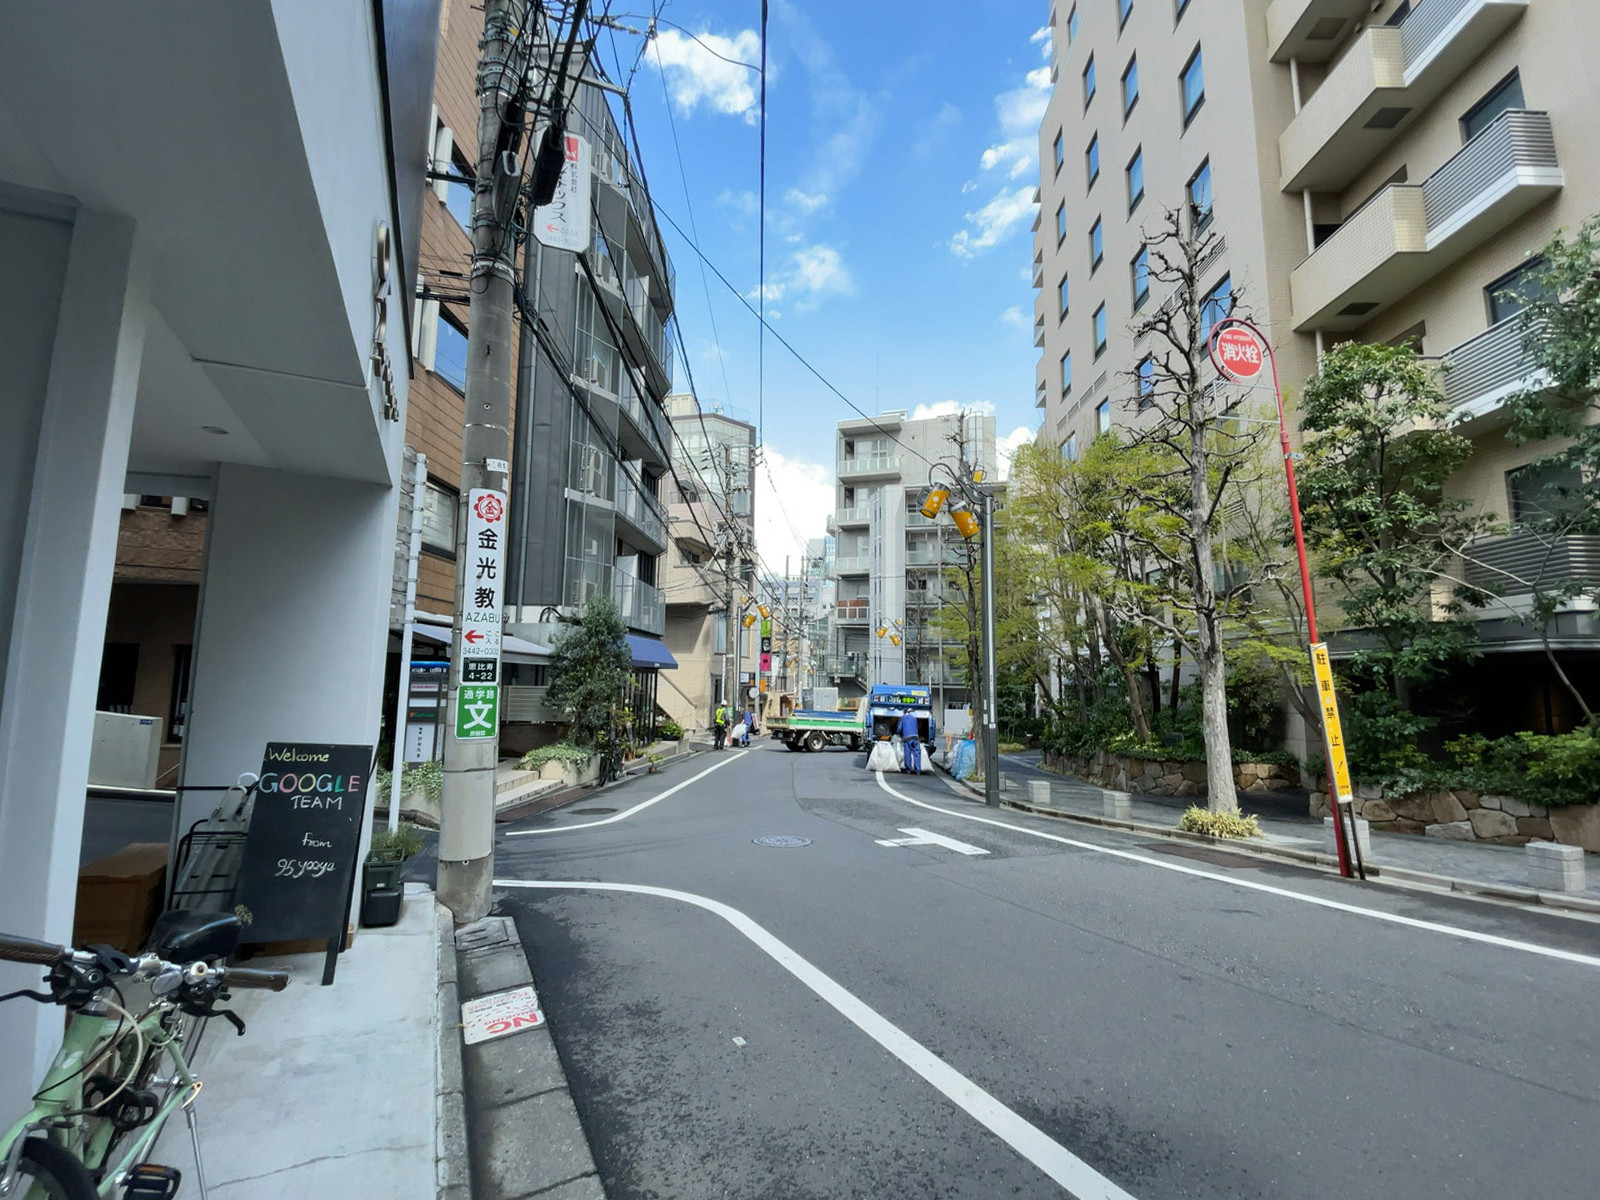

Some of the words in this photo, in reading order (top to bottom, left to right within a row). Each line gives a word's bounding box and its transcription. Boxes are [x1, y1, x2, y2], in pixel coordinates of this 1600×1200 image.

[1221, 342, 1260, 364] 消火栓
[482, 501, 498, 515] 金
[474, 528, 498, 609] 金光教
[462, 647, 499, 655] 3442-0302
[468, 663, 494, 671] 恵比寿
[468, 671, 493, 680] 4-22
[463, 690, 495, 700] 通学路
[463, 700, 494, 730] 文
[268, 747, 330, 762] Welcome
[258, 772, 361, 793] GOOGLE
[290, 794, 343, 810] TEAM
